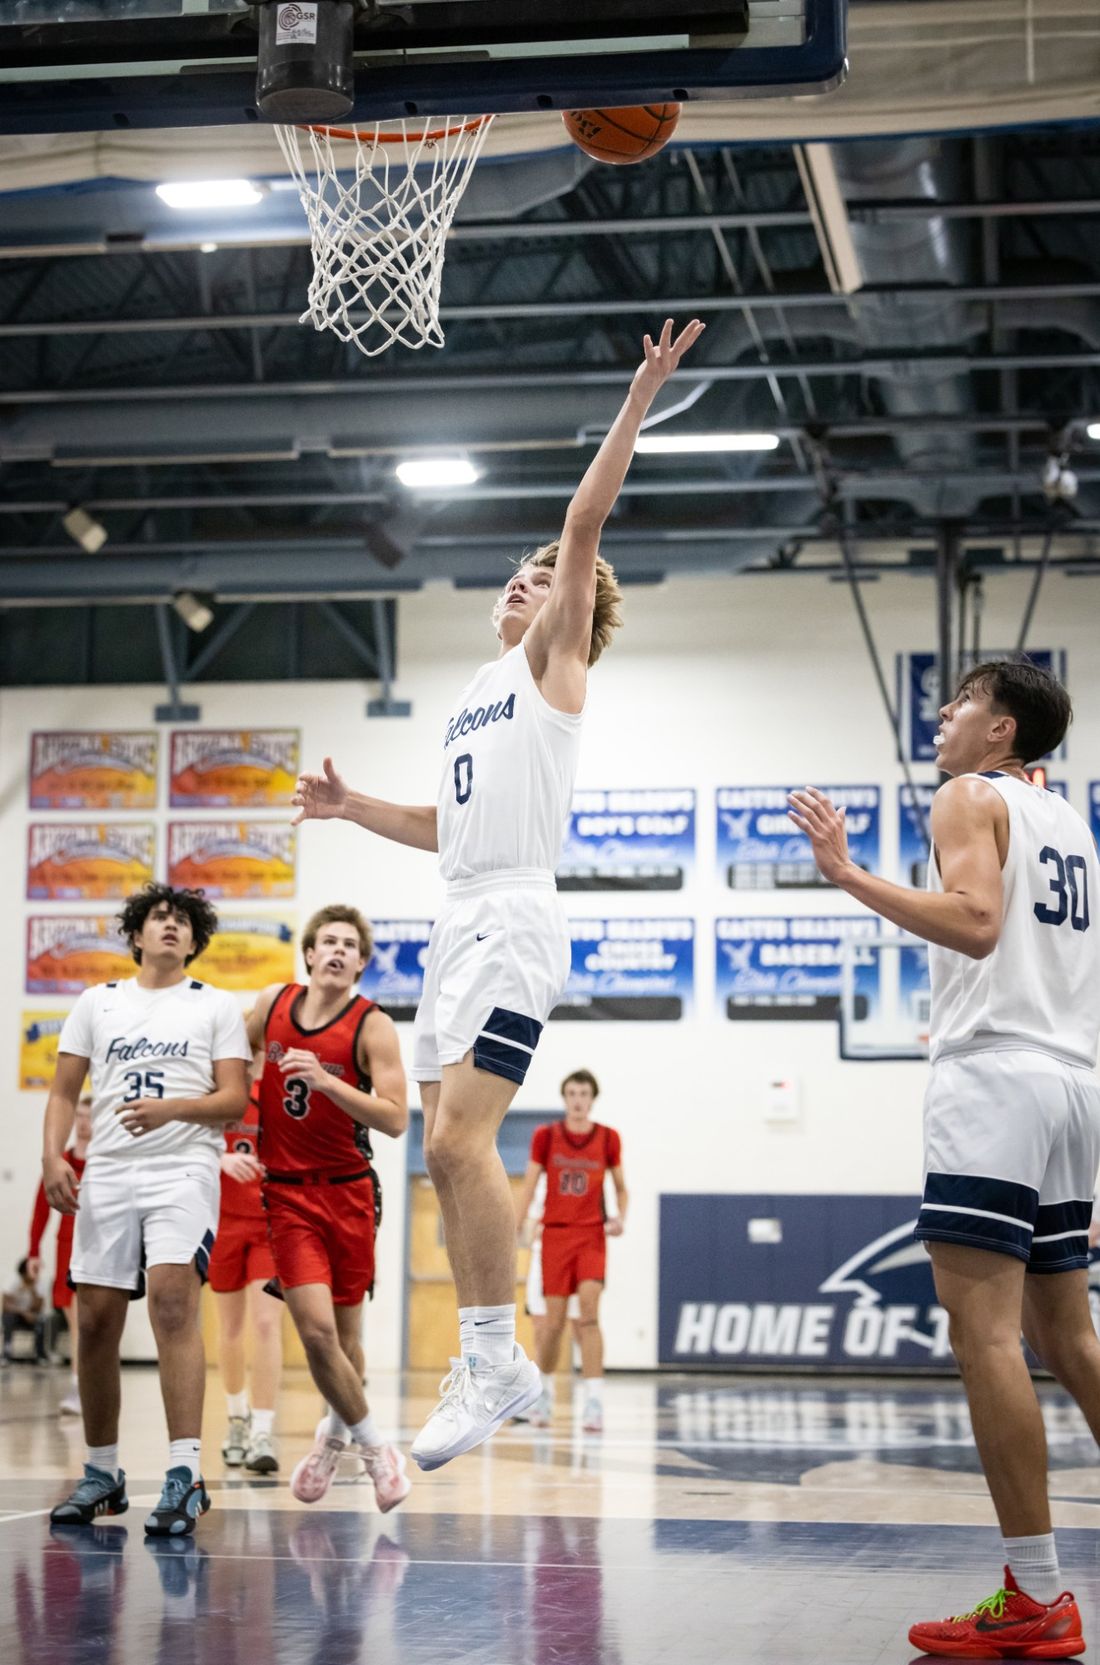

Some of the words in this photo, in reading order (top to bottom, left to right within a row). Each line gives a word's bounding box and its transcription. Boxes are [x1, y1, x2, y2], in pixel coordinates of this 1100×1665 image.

[454, 753, 473, 805] 0
[1034, 845, 1090, 933] 30
[105, 1037, 189, 1064] Falcons
[123, 1071, 164, 1103] 35
[283, 1078, 311, 1120] 3
[675, 1303, 835, 1357] HOME
[842, 1305, 917, 1358] OF
